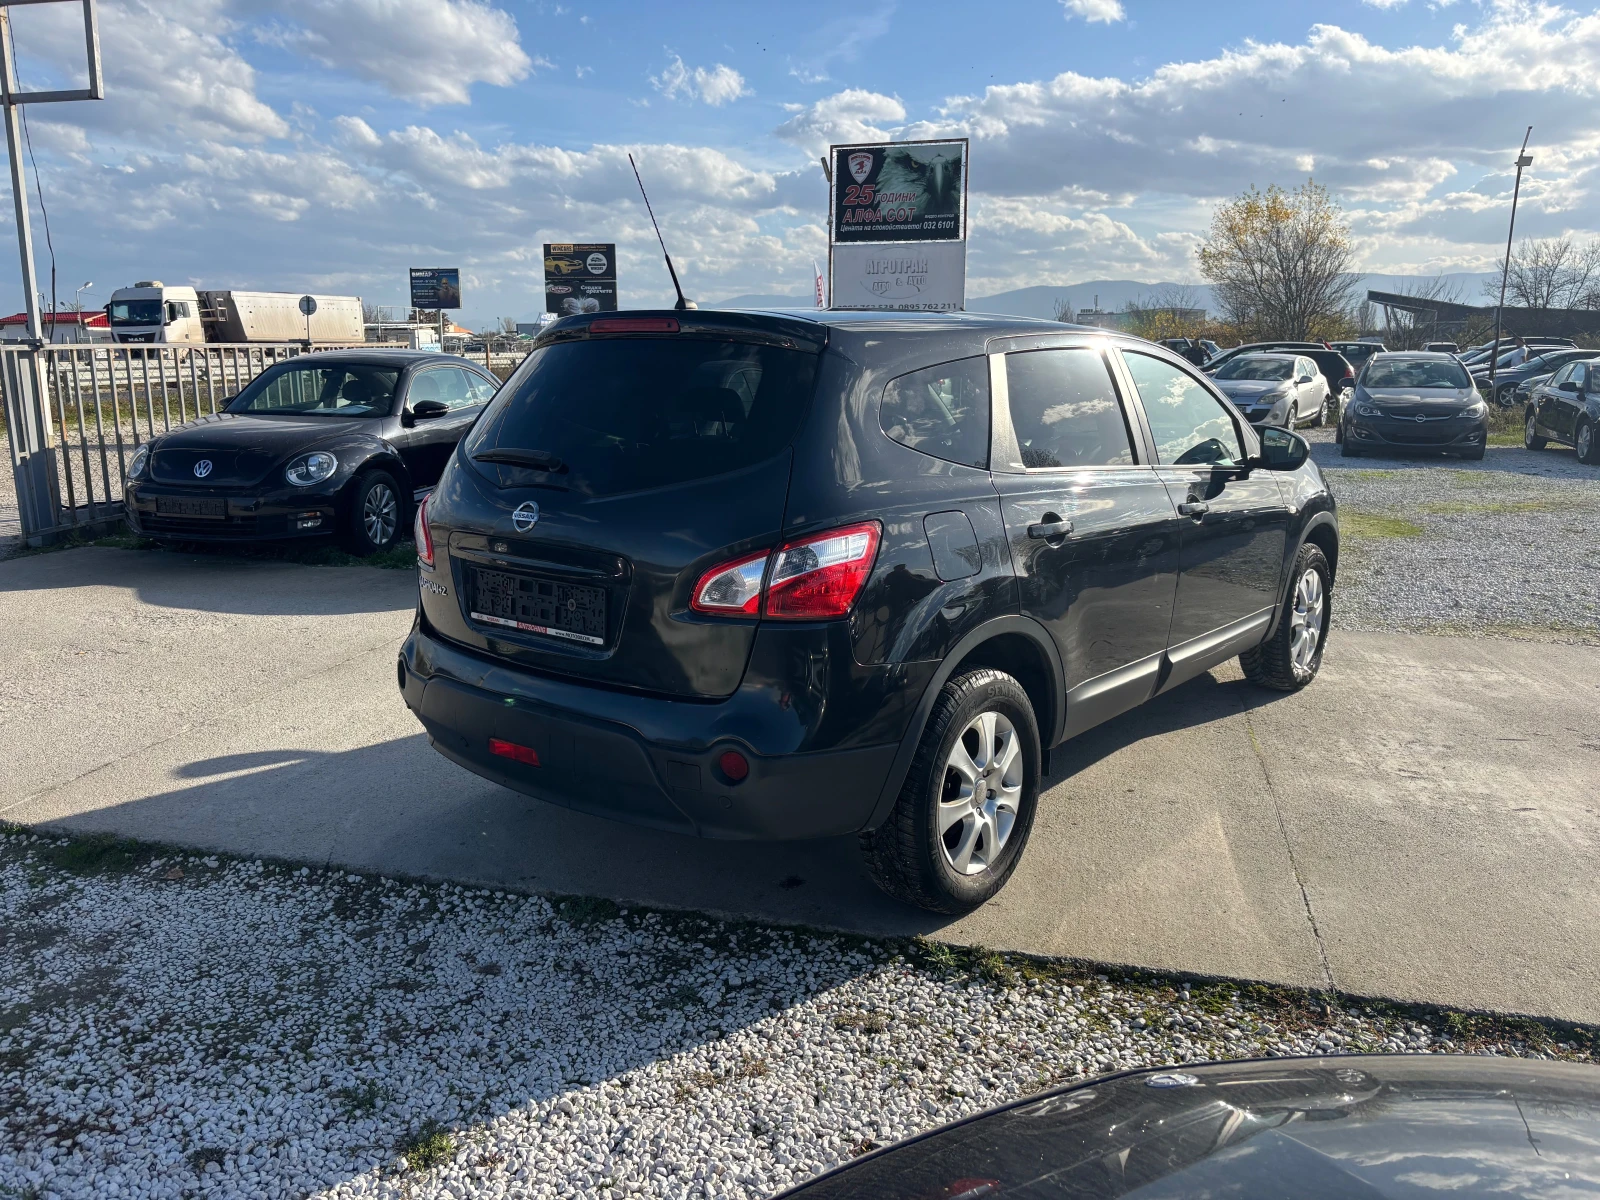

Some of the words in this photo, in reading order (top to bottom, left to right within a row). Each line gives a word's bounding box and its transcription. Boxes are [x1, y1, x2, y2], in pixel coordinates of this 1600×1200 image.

[842, 184, 876, 206] 25
[842, 207, 883, 224] АЛФА
[886, 206, 916, 222] СОТ
[840, 224, 863, 232] Цената
[872, 223, 922, 231] спокойствието!
[923, 221, 936, 230] 032
[937, 220, 954, 229] 6101
[865, 258, 928, 274] АГРОТРАК
[872, 280, 891, 292] АГРО
